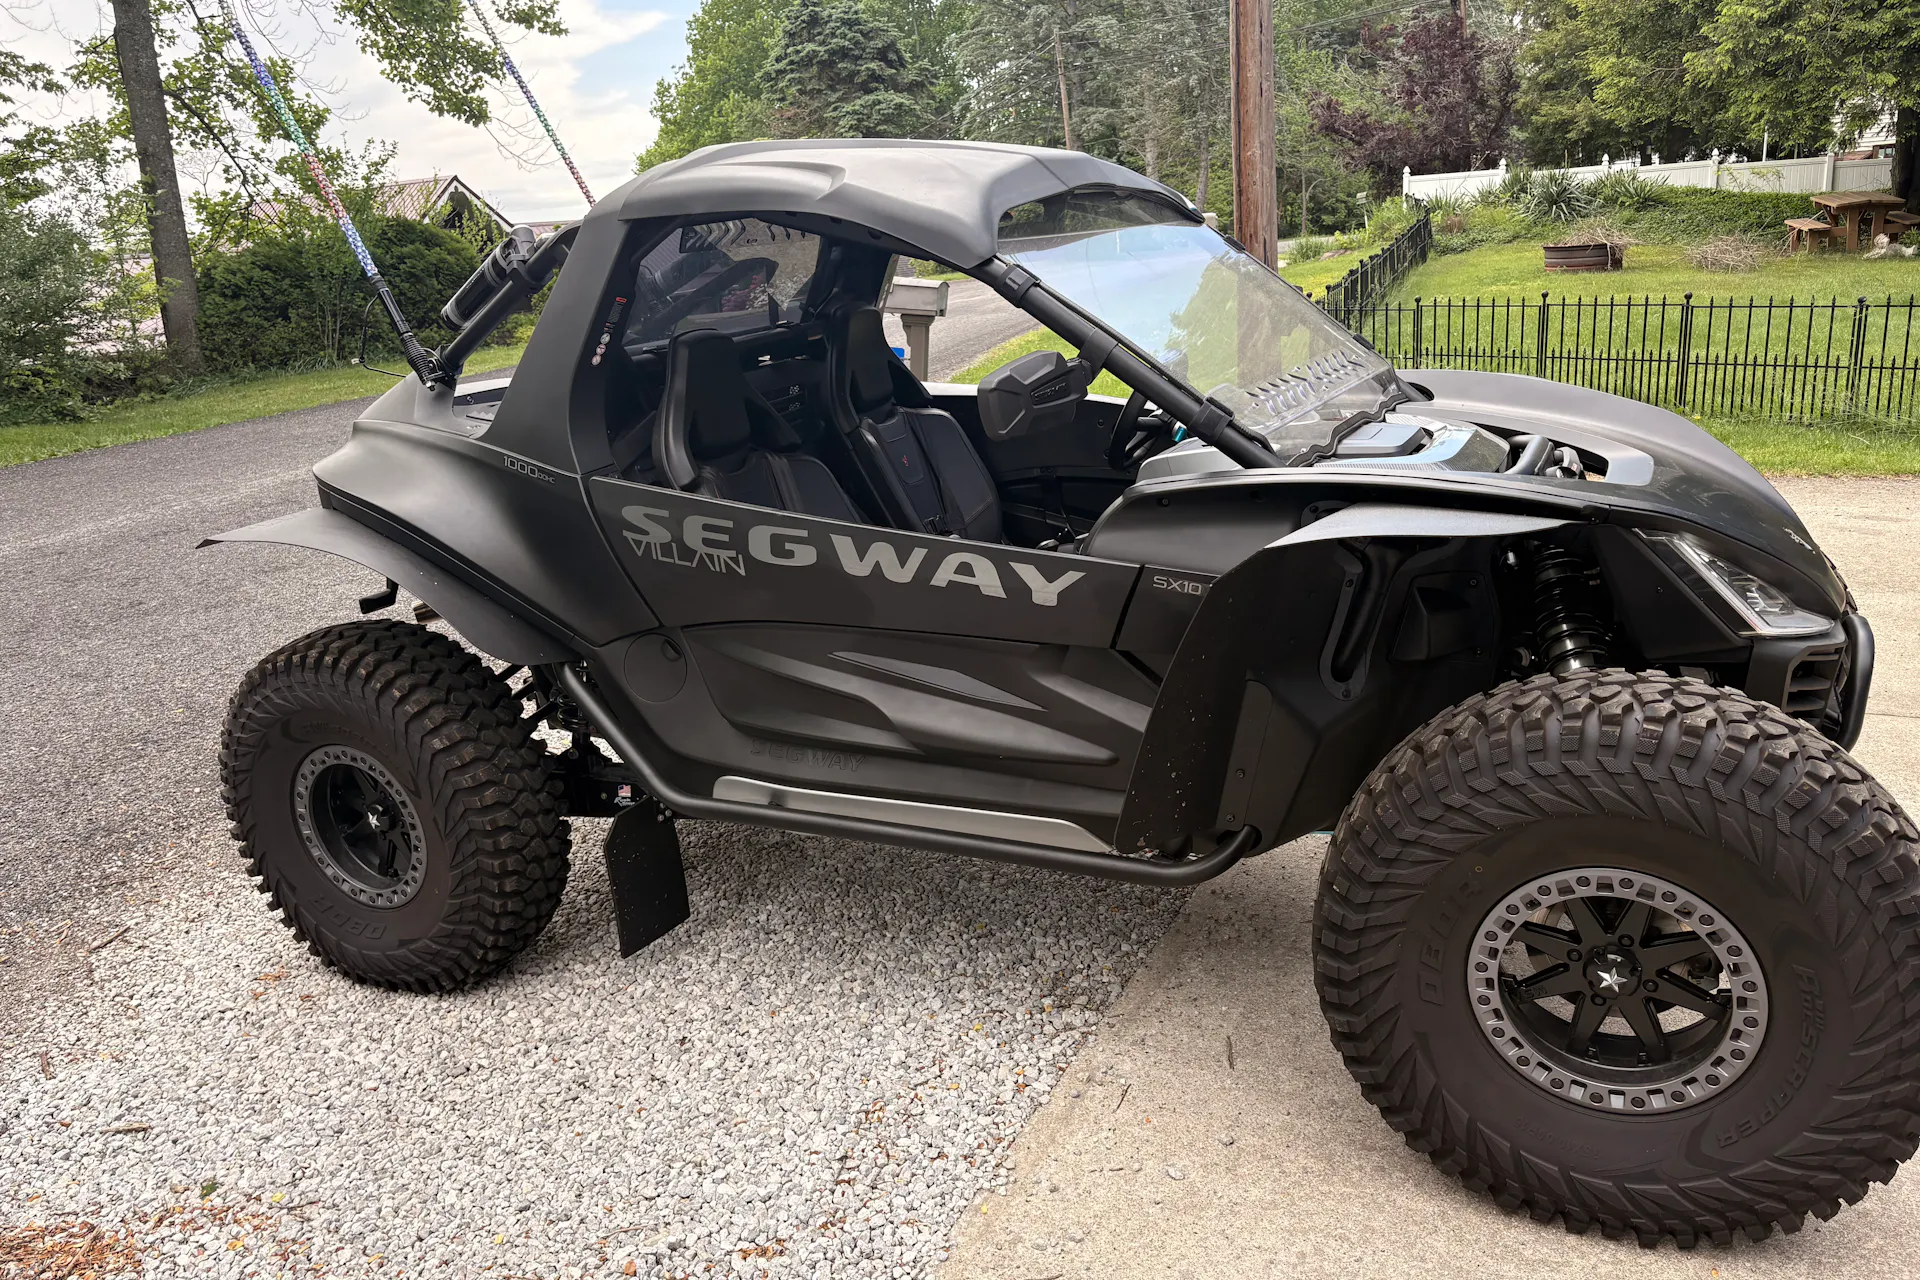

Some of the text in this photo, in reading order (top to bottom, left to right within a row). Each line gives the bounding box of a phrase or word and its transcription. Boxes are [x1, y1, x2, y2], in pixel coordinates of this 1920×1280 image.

[621, 505, 1086, 607] SEGWAY
[624, 534, 746, 577] VILLAIN
[749, 738, 866, 773] SEGWAY
